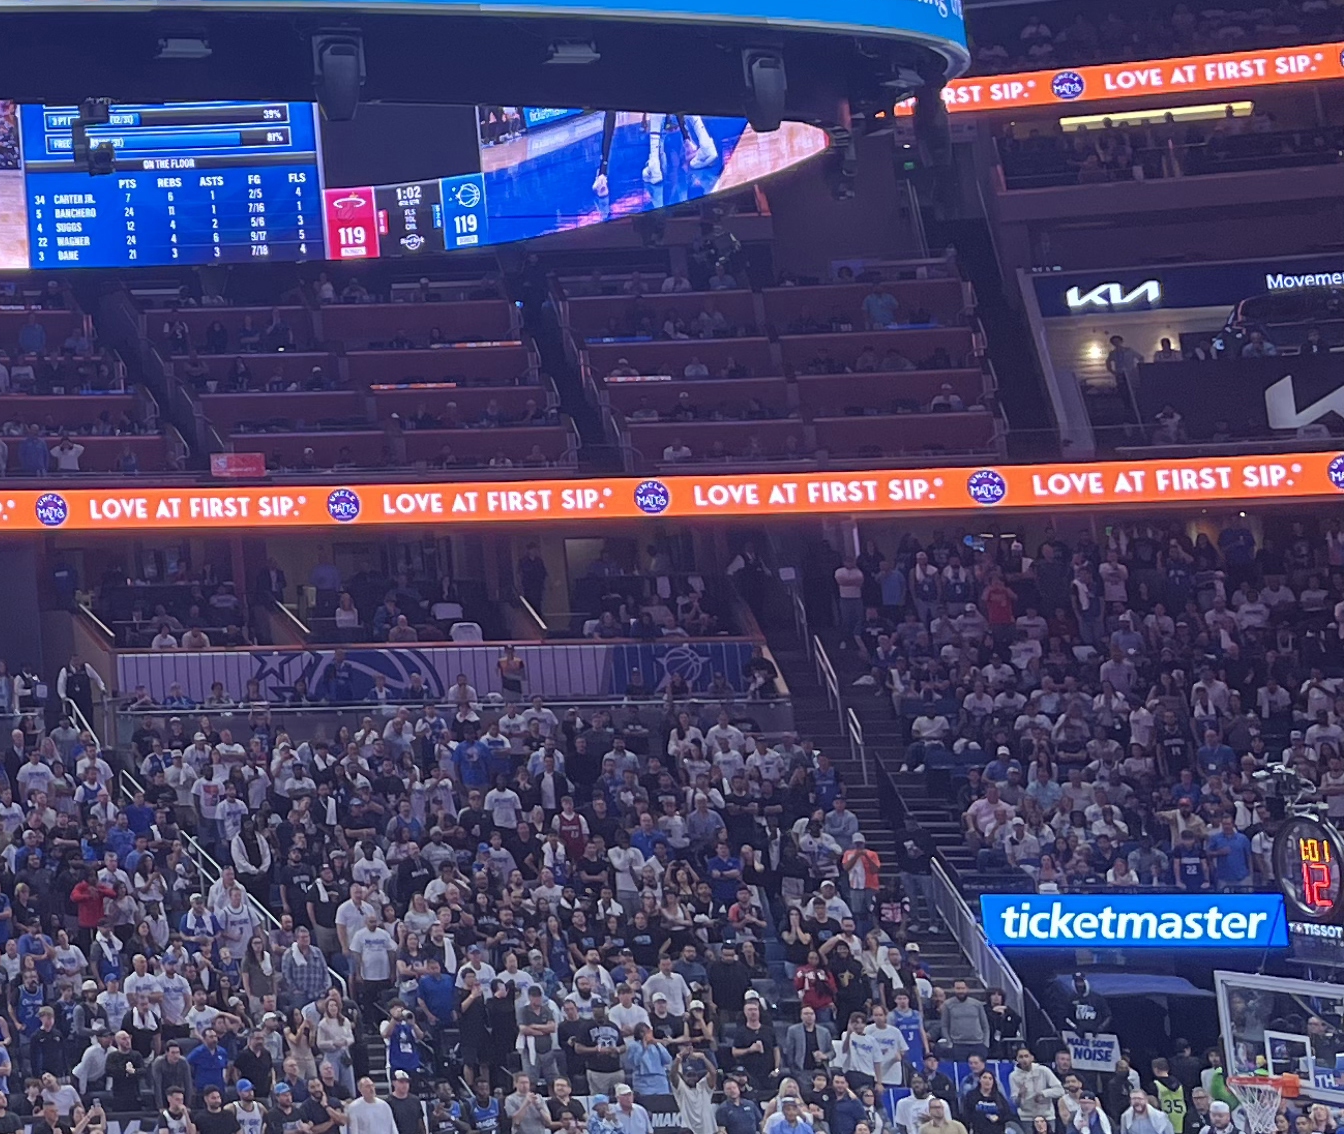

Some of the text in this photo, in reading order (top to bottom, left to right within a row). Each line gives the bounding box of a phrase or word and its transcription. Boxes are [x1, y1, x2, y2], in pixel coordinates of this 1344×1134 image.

[1103, 68, 1163, 91] LOVE
[1170, 65, 1197, 84] AT
[1204, 58, 1267, 82] FIRST
[338, 226, 366, 245] 119
[1266, 272, 1344, 290] Moveme
[1300, 838, 1330, 862] 1:01
[1302, 862, 1333, 907] 12
[1001, 902, 1268, 940] ticketmaster
[1303, 923, 1343, 938] TISSOT
[1073, 1047, 1112, 1062] NOISE
[1163, 1099, 1184, 1113] 35
